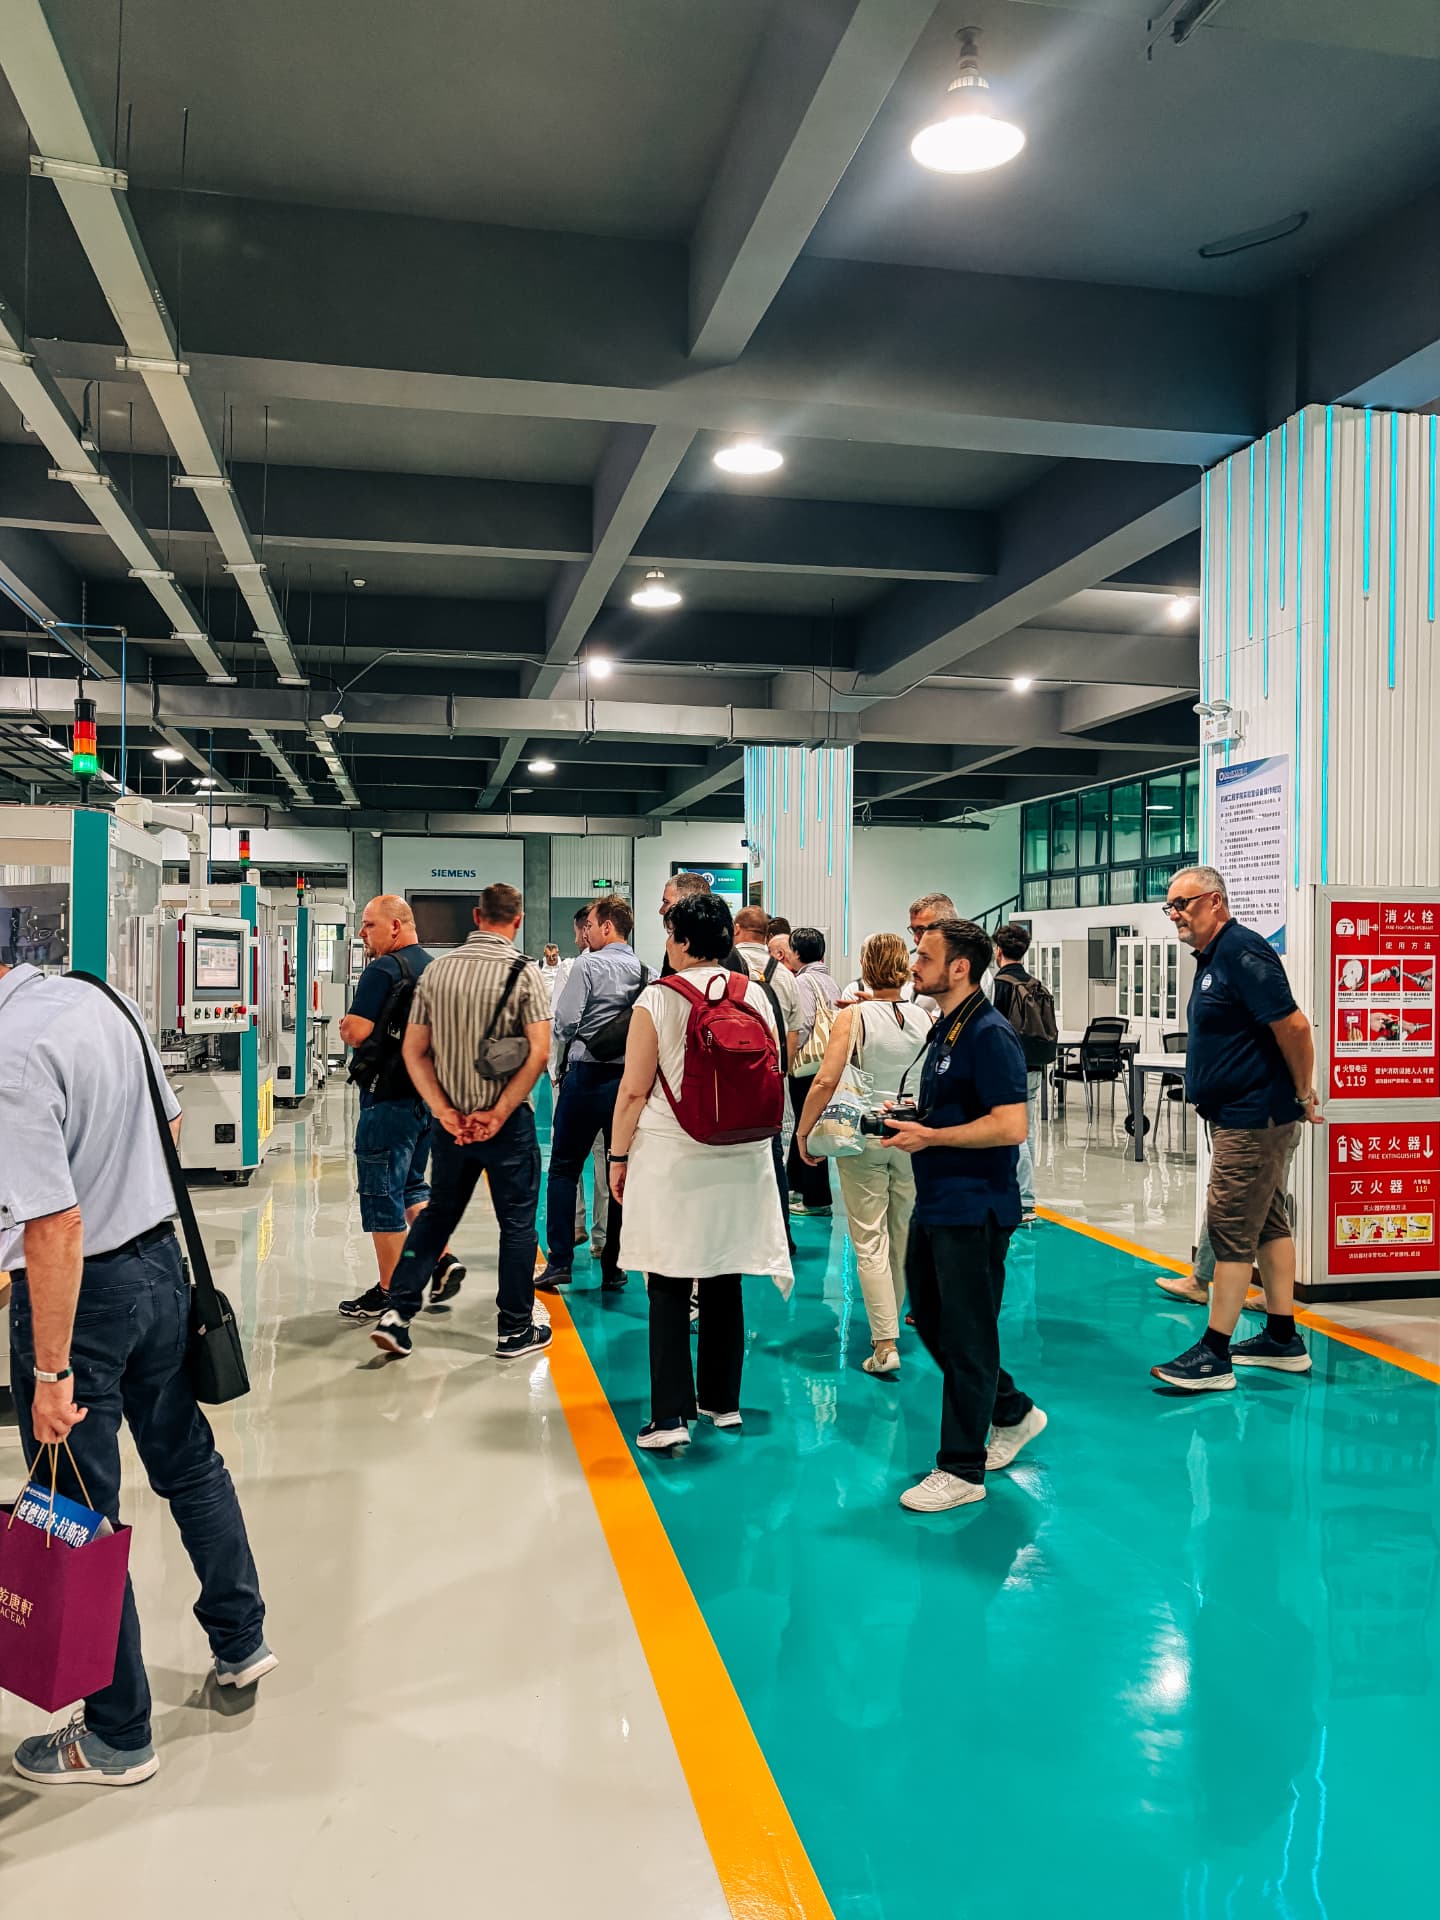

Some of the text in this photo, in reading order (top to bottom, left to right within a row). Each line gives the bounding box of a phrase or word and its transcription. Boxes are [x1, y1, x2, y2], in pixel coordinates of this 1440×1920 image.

[431, 868, 476, 878] SIEMENS
[1384, 909, 1434, 924] 消火栓
[1385, 941, 1431, 950] 使用方法
[1342, 1064, 1367, 1073] 火警电话
[1346, 1075, 1367, 1087] 119
[1367, 1135, 1420, 1151] 灭火器
[1381, 1152, 1421, 1160] EXTINGUISHER
[1349, 1179, 1403, 1196] 灭火器
[1415, 1185, 1428, 1193] 119
